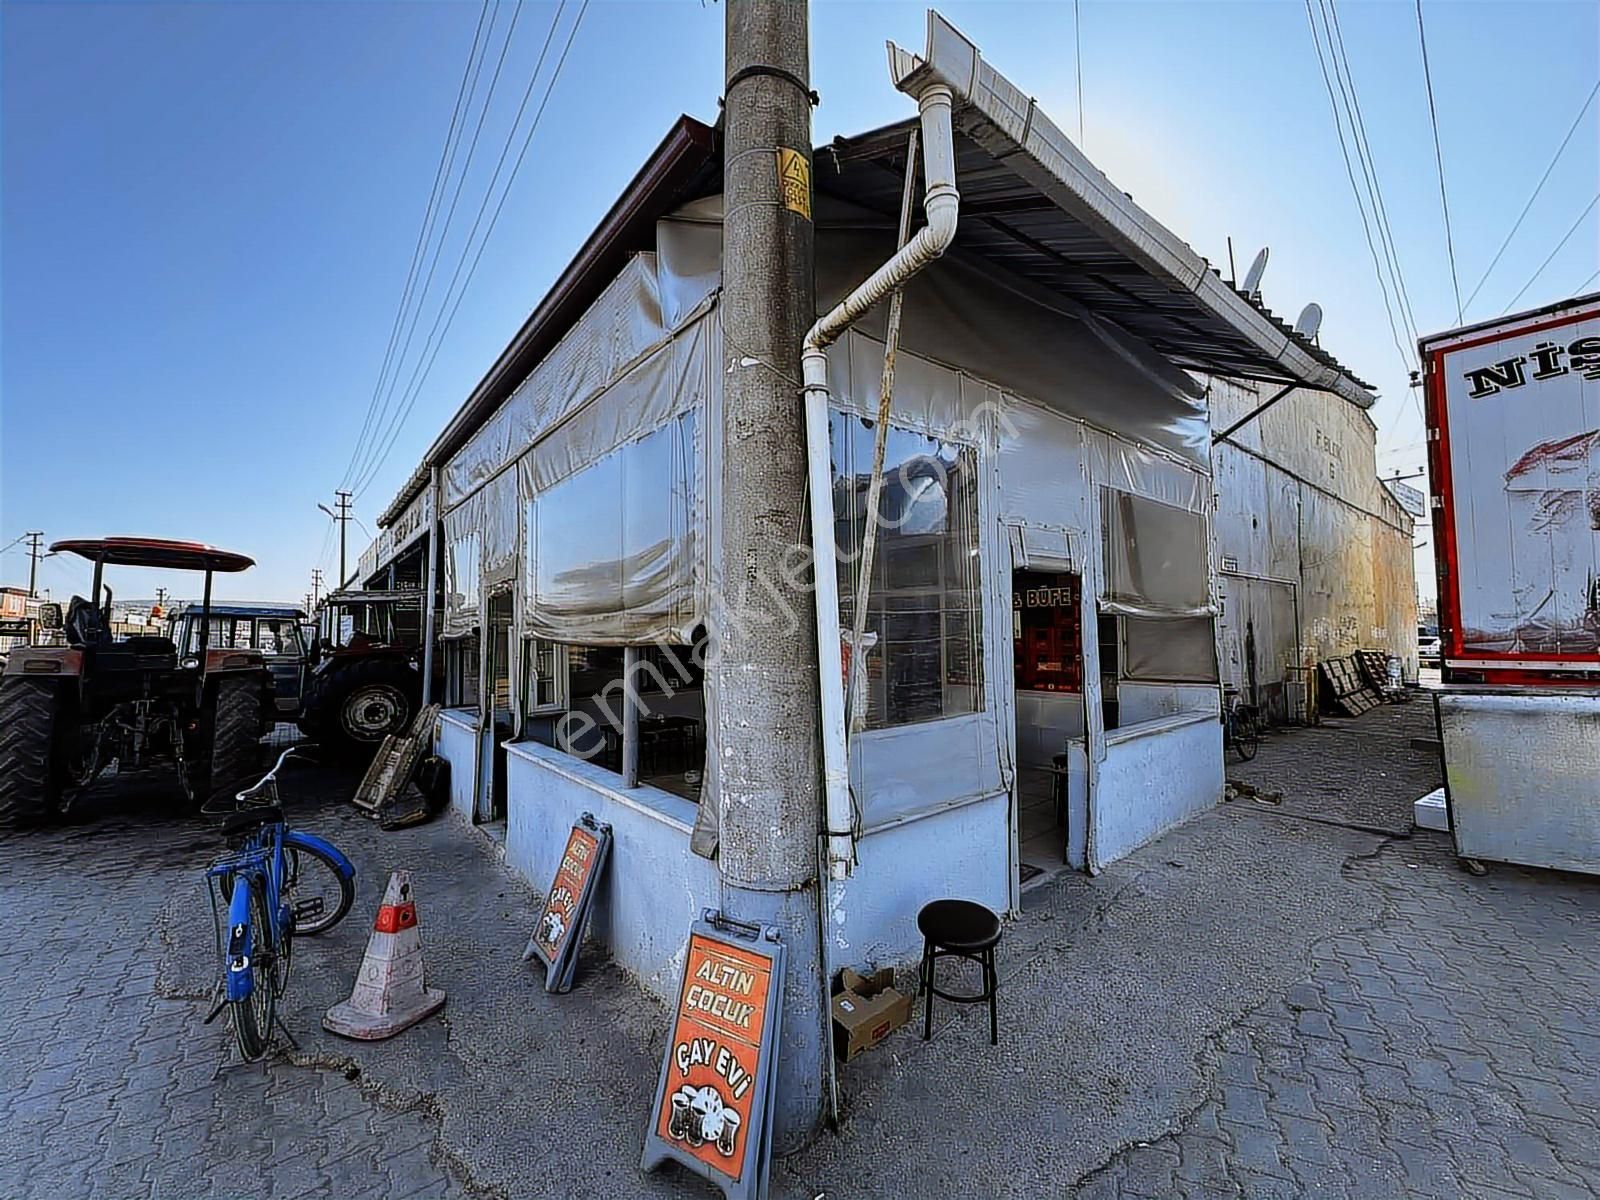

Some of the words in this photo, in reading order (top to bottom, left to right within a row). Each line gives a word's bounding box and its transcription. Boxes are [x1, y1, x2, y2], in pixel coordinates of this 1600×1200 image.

[1026, 585, 1072, 608] BÜFE
[695, 958, 755, 996] ALTIN
[685, 984, 756, 1029] ÇOCUK
[676, 1037, 718, 1077] ÇAY
[715, 1049, 753, 1099] EVİ
